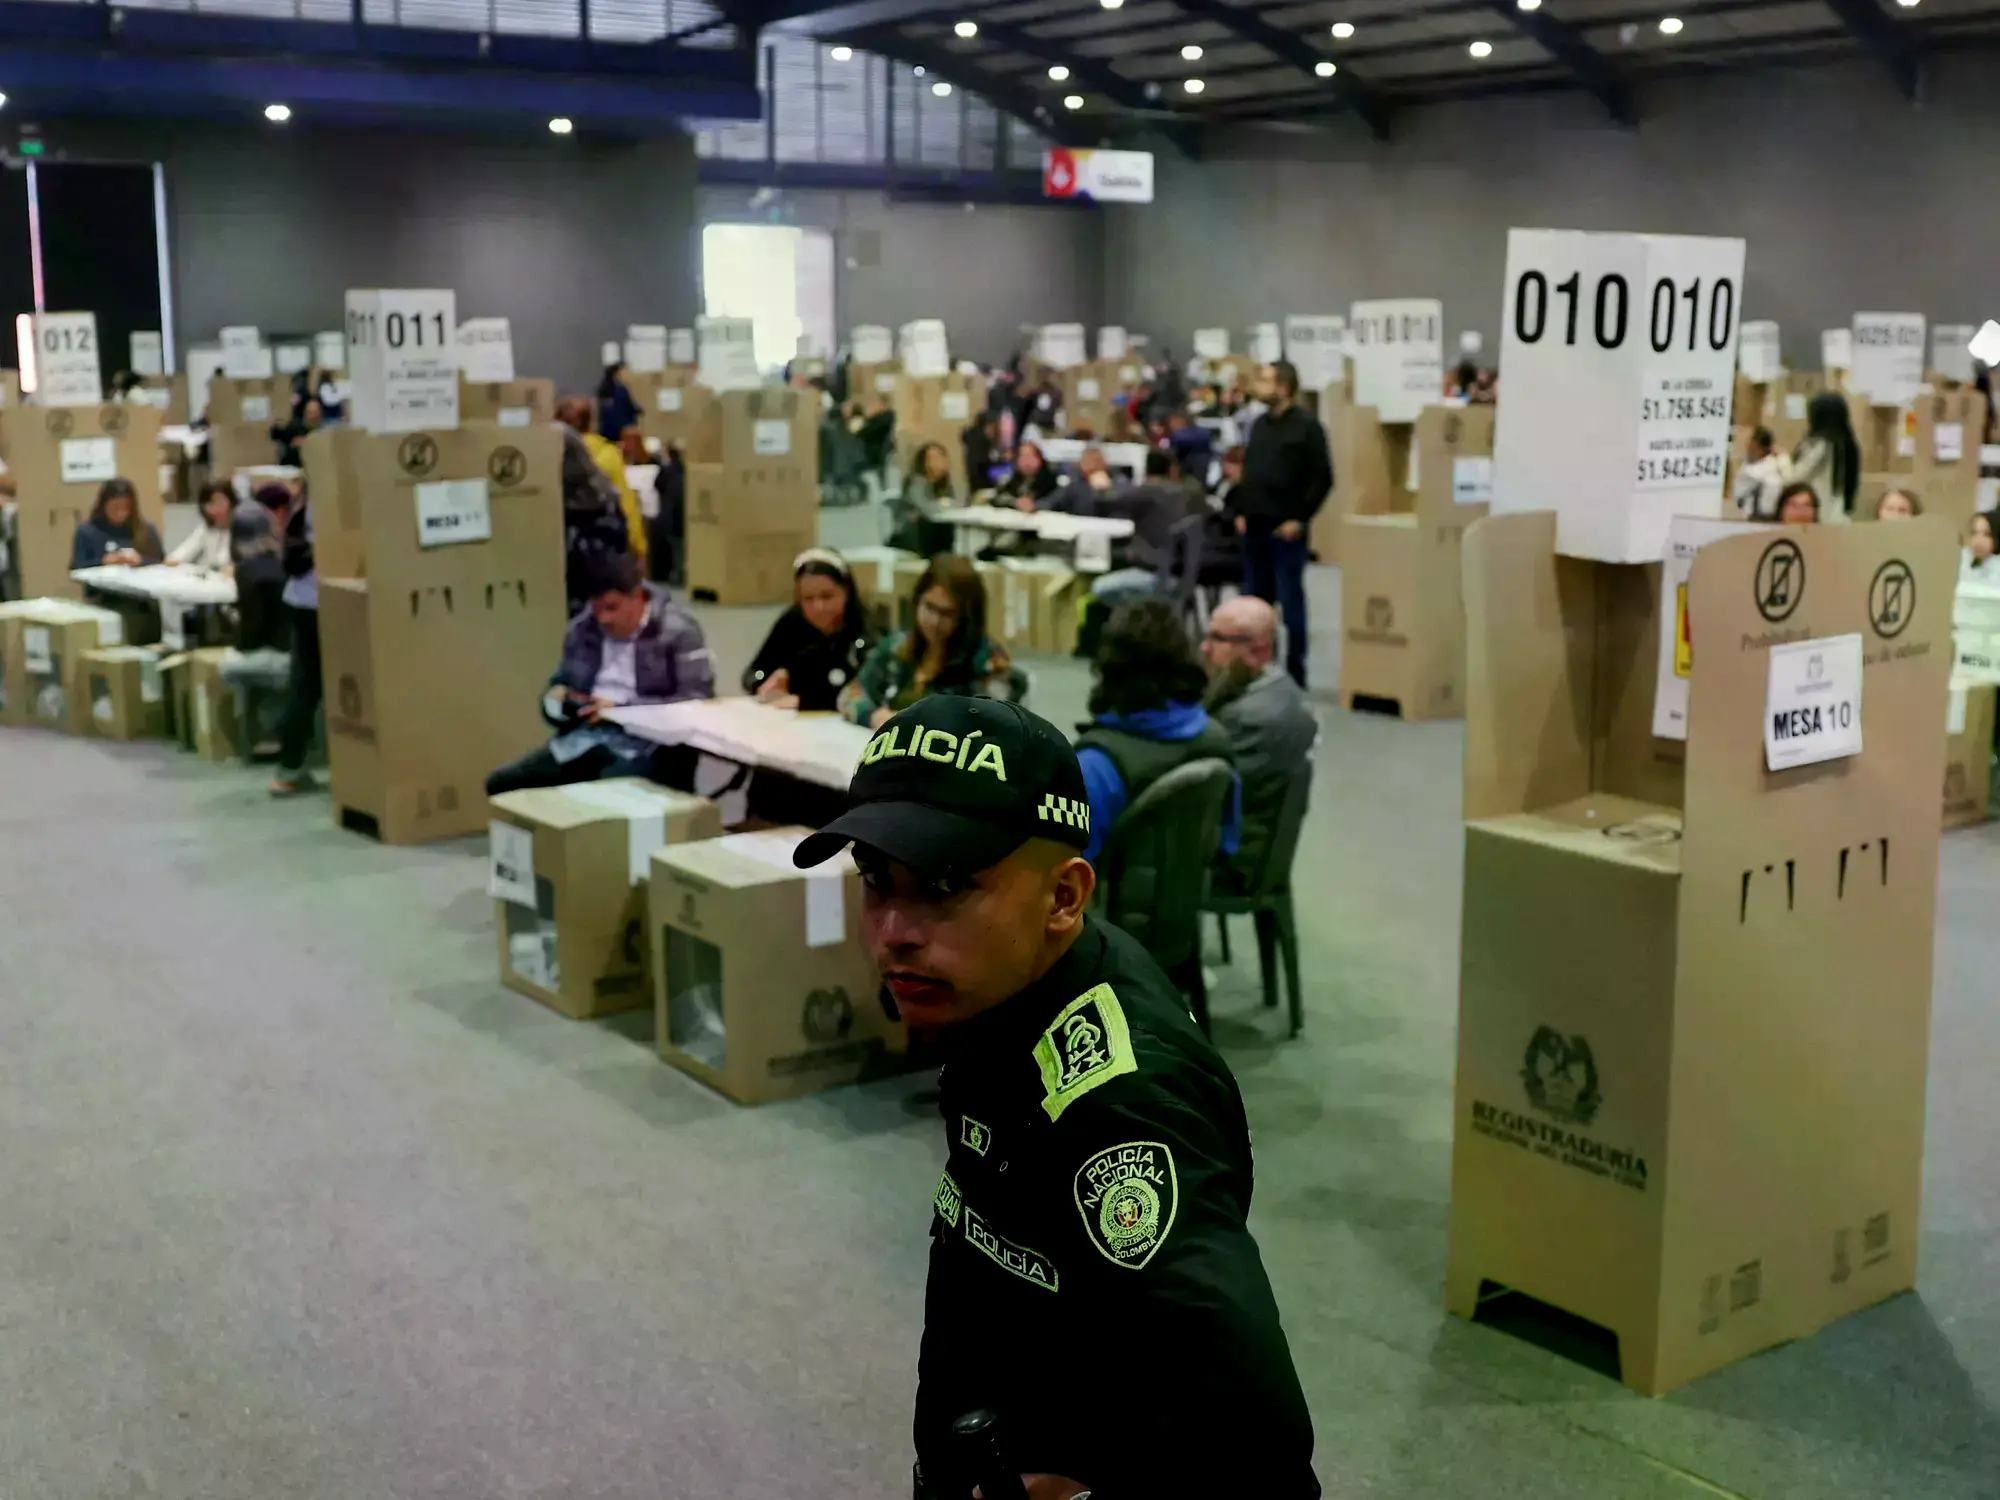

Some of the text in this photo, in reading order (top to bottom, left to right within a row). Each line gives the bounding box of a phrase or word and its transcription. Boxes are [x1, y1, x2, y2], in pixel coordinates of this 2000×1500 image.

[1515, 270, 1629, 349] 010
[1650, 276, 1734, 353] 010
[43, 327, 92, 353] 012
[386, 312, 445, 348] 011
[1774, 701, 1851, 741] MESA 10
[1086, 1146, 1154, 1183] POLICÍA
[1084, 1164, 1164, 1209] NACIONAL
[973, 1223, 1047, 1281] POLICÍA
[1115, 1238, 1157, 1258] COLOMBIA
